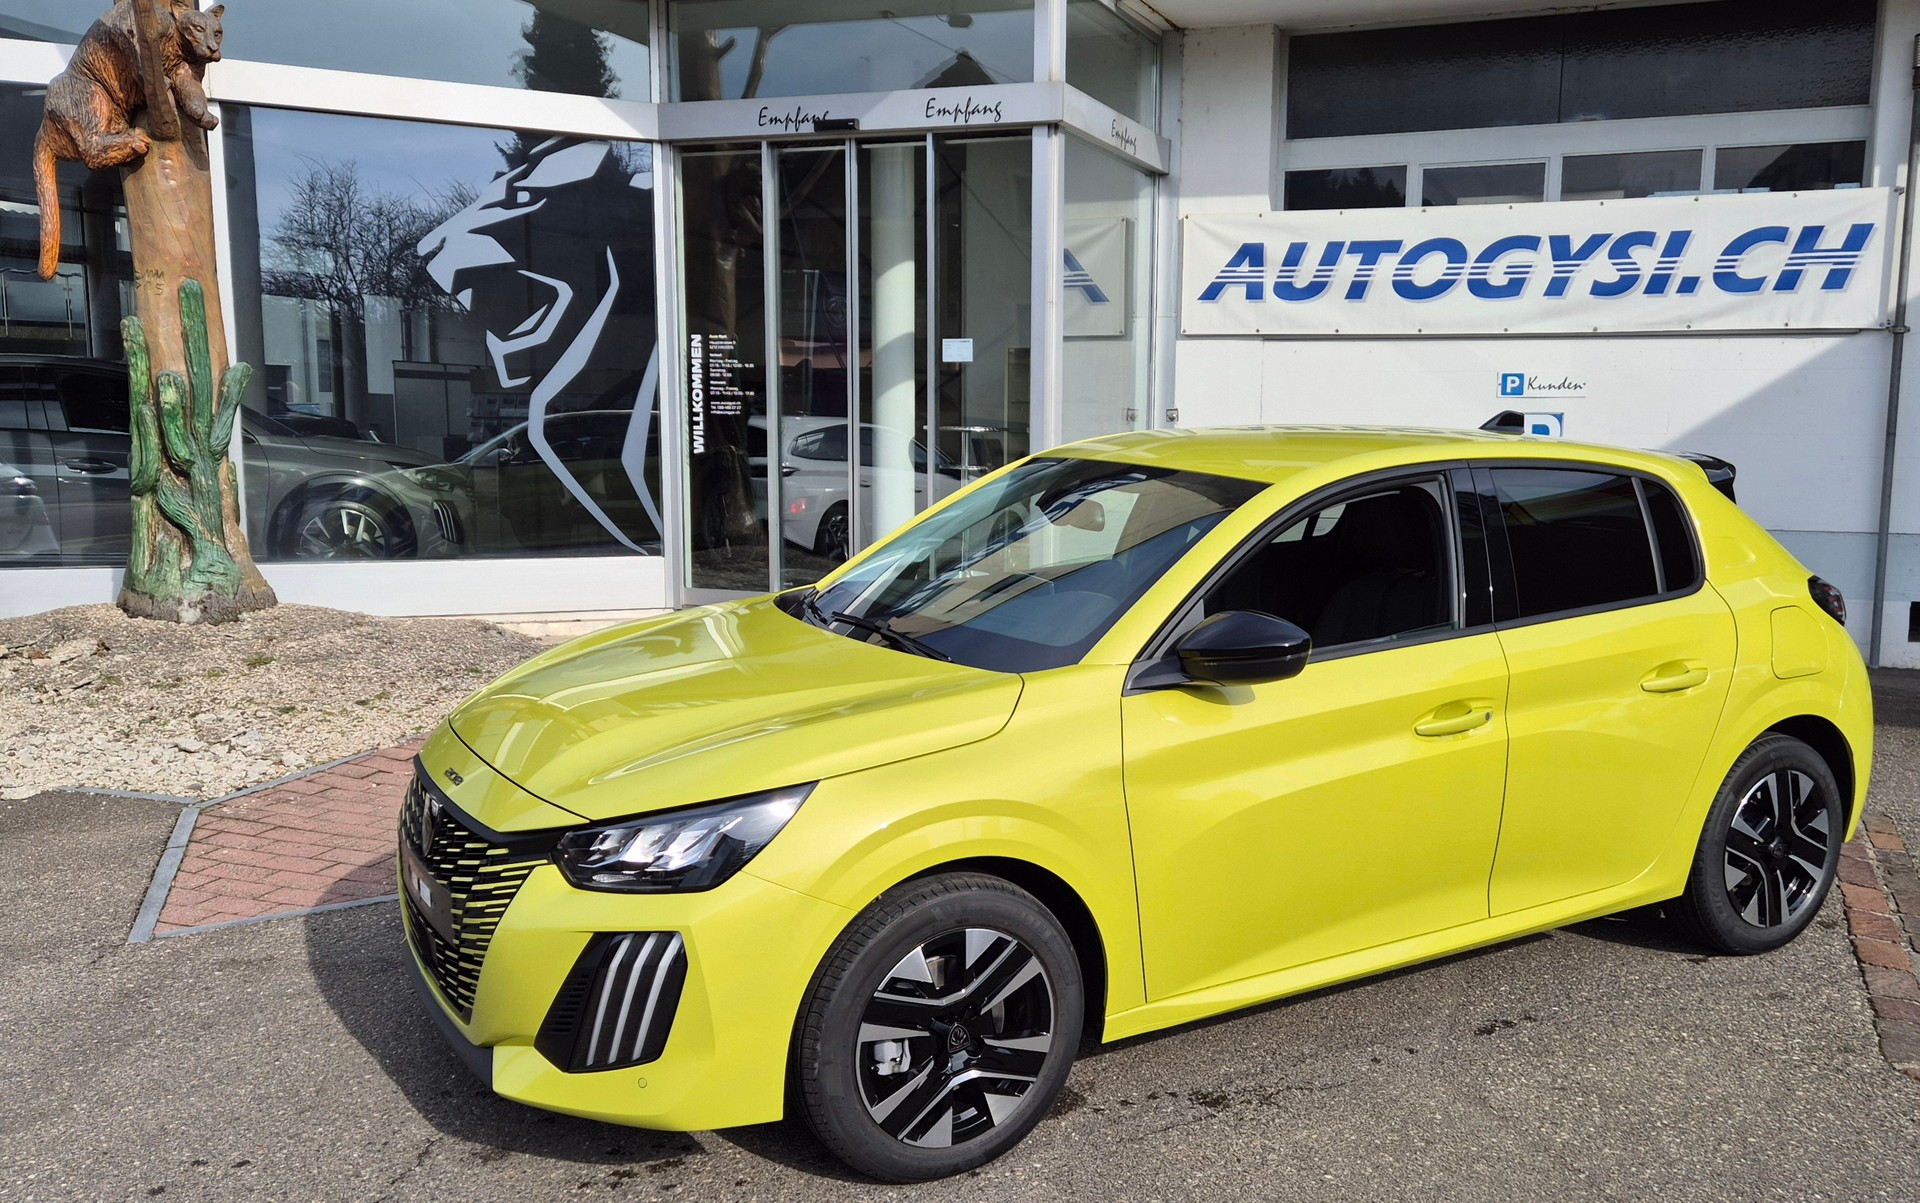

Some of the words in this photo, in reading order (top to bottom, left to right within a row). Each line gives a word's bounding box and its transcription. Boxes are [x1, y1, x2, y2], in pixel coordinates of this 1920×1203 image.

[925, 96, 1002, 123] Empfang
[1197, 222, 1876, 302] AUTOGYSI.CH
[691, 334, 705, 454] WILLKOMMEN
[1506, 376, 1520, 393] P
[1527, 376, 1583, 390] Kunden
